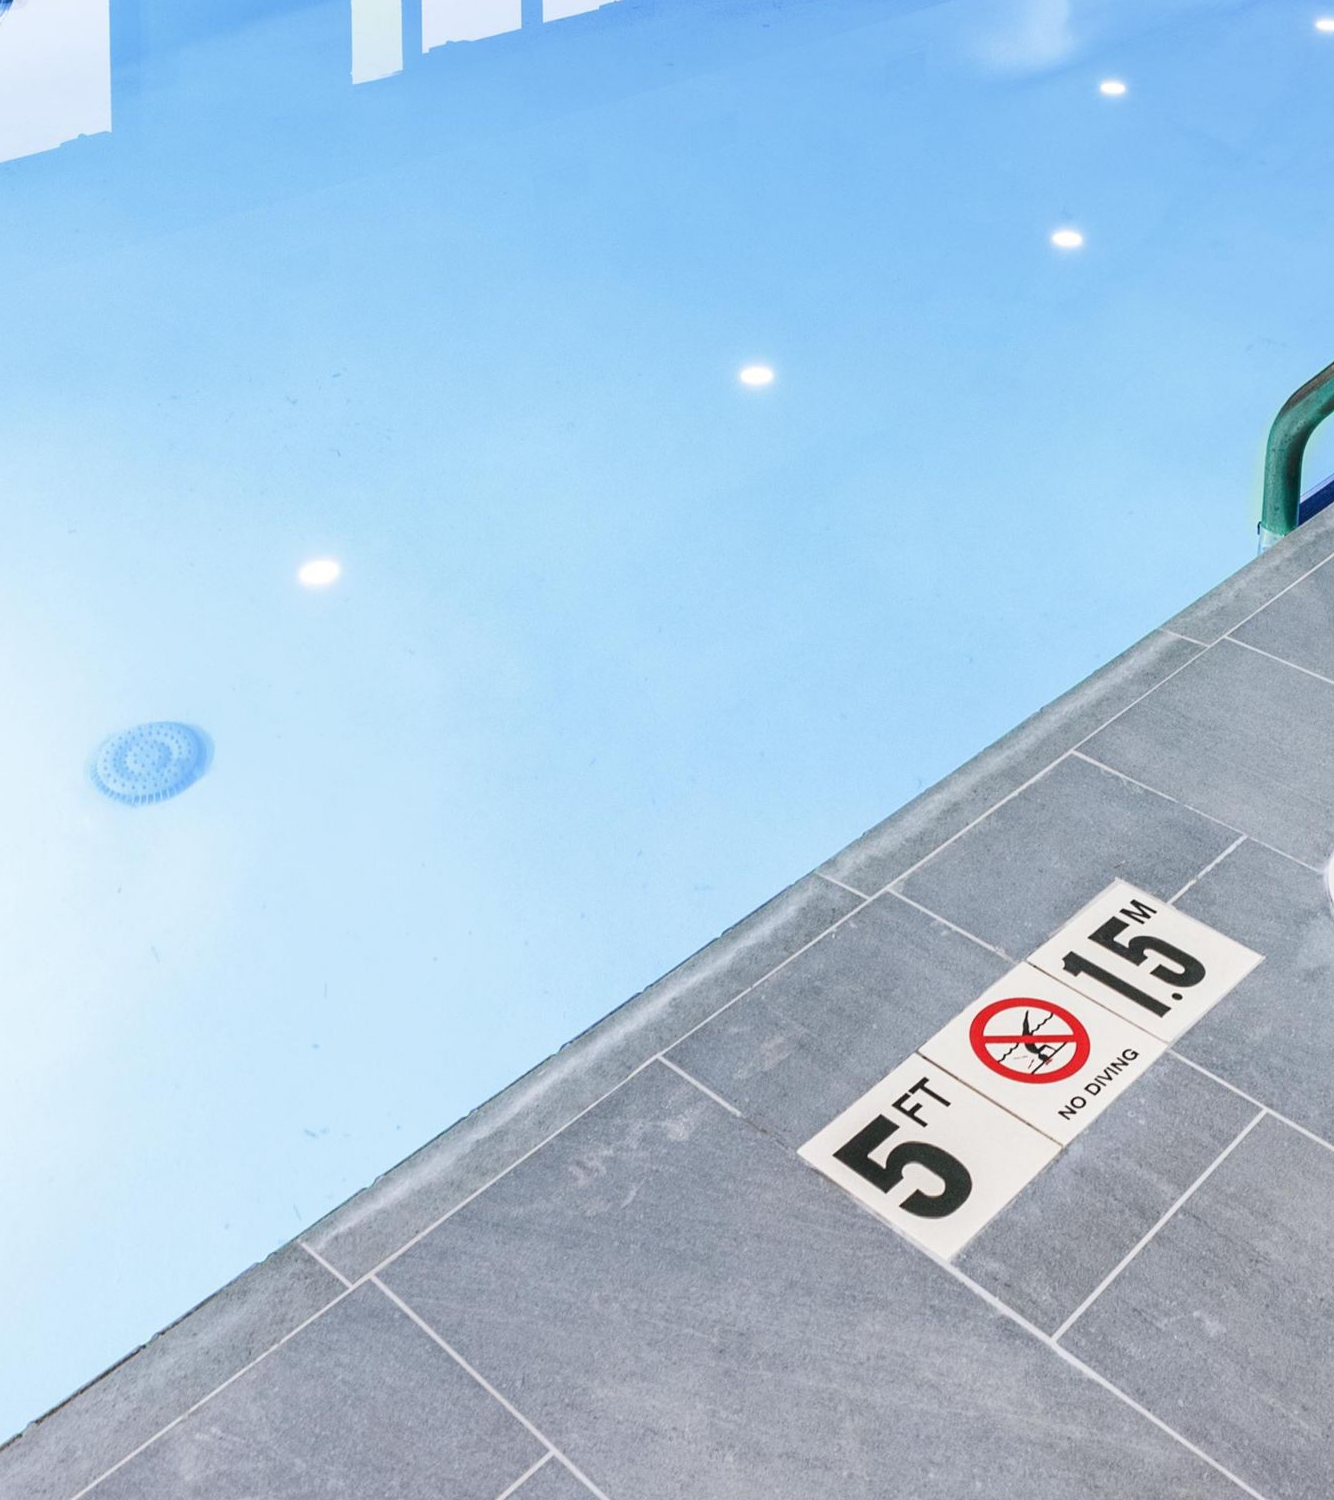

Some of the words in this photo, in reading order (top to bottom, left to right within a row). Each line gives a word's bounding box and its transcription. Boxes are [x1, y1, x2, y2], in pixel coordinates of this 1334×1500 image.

[1062, 916, 1206, 1018] 1.5
[892, 1076, 952, 1128] FT
[1058, 1094, 1088, 1120] NO
[1084, 1048, 1139, 1102] DIVING
[832, 1114, 973, 1220] 5
